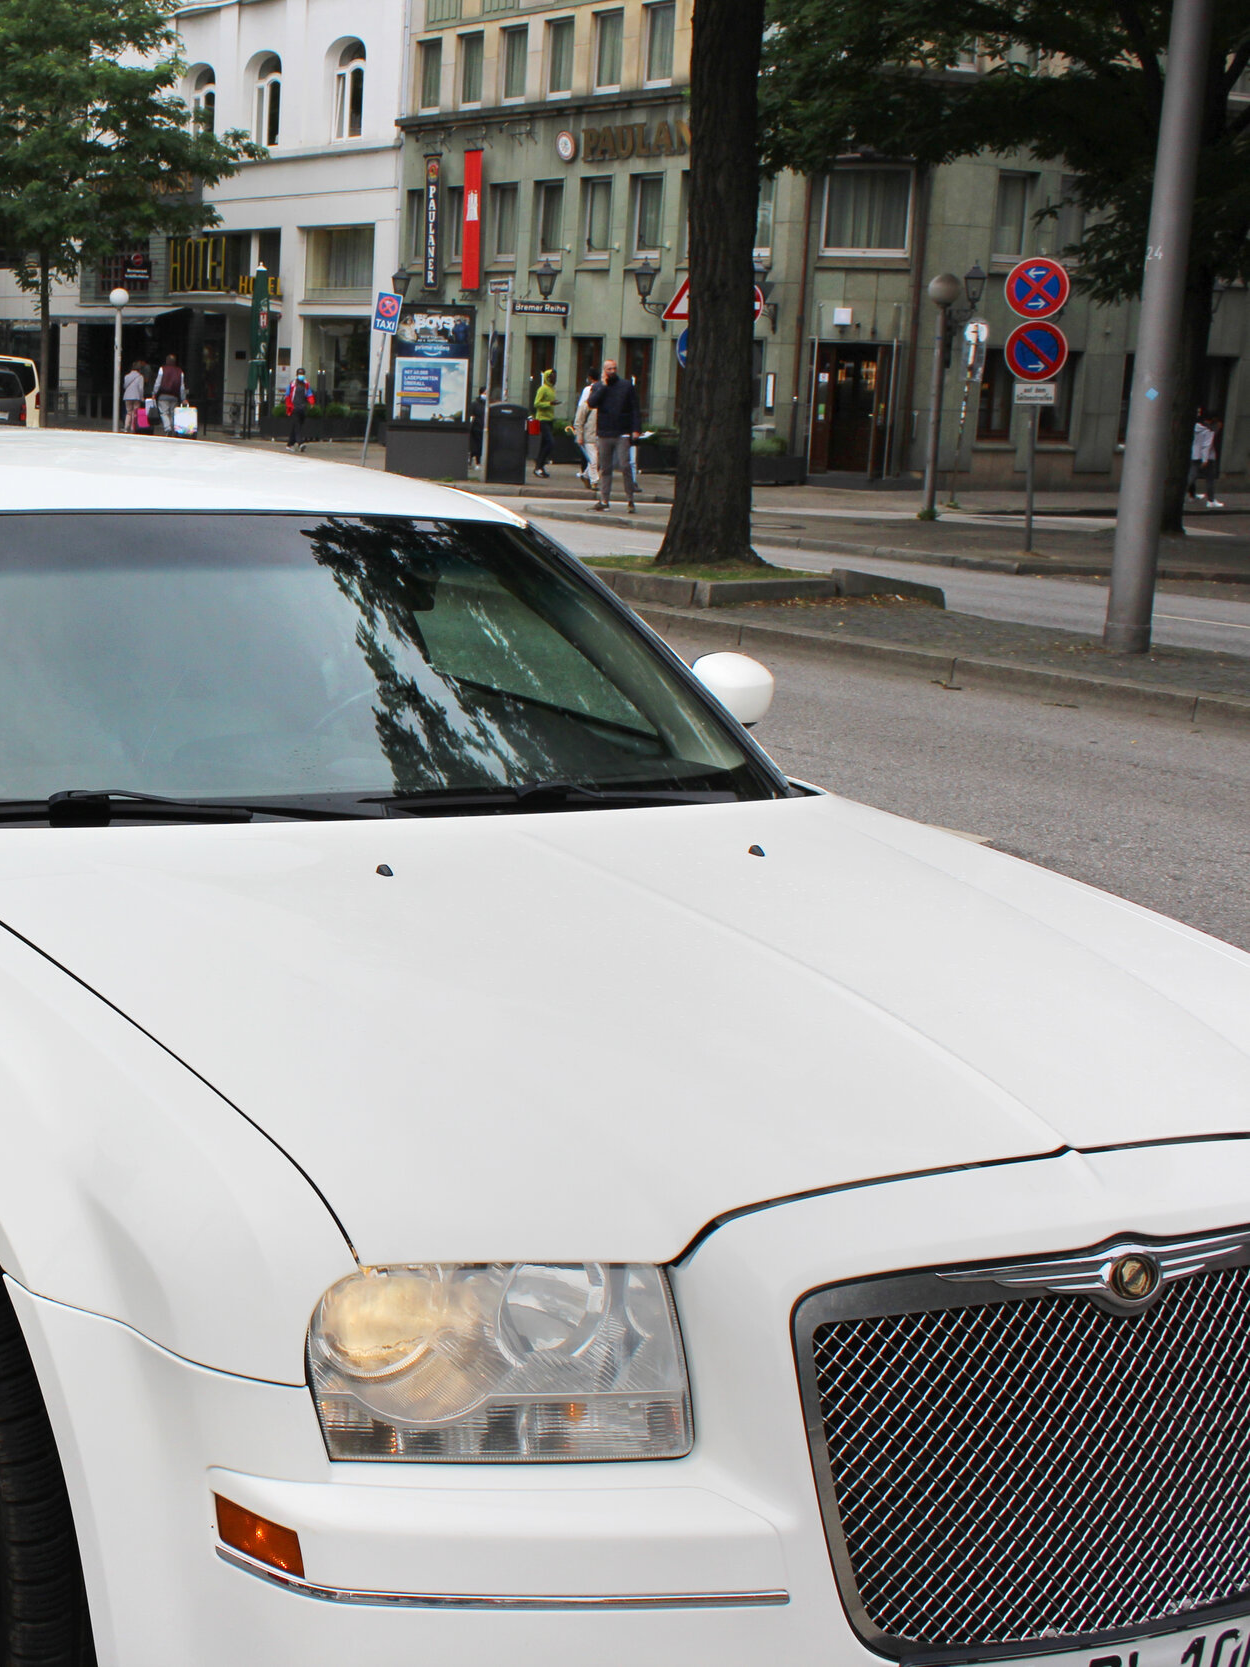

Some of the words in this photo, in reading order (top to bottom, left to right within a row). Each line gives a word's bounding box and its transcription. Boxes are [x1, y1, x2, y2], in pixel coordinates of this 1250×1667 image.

[427, 185, 437, 283] PAULANER
[1147, 245, 1164, 260] 24
[170, 236, 231, 291] HOTEL
[515, 303, 543, 311] Bremer
[544, 304, 567, 312] Reihe
[375, 318, 395, 331] TAXI
